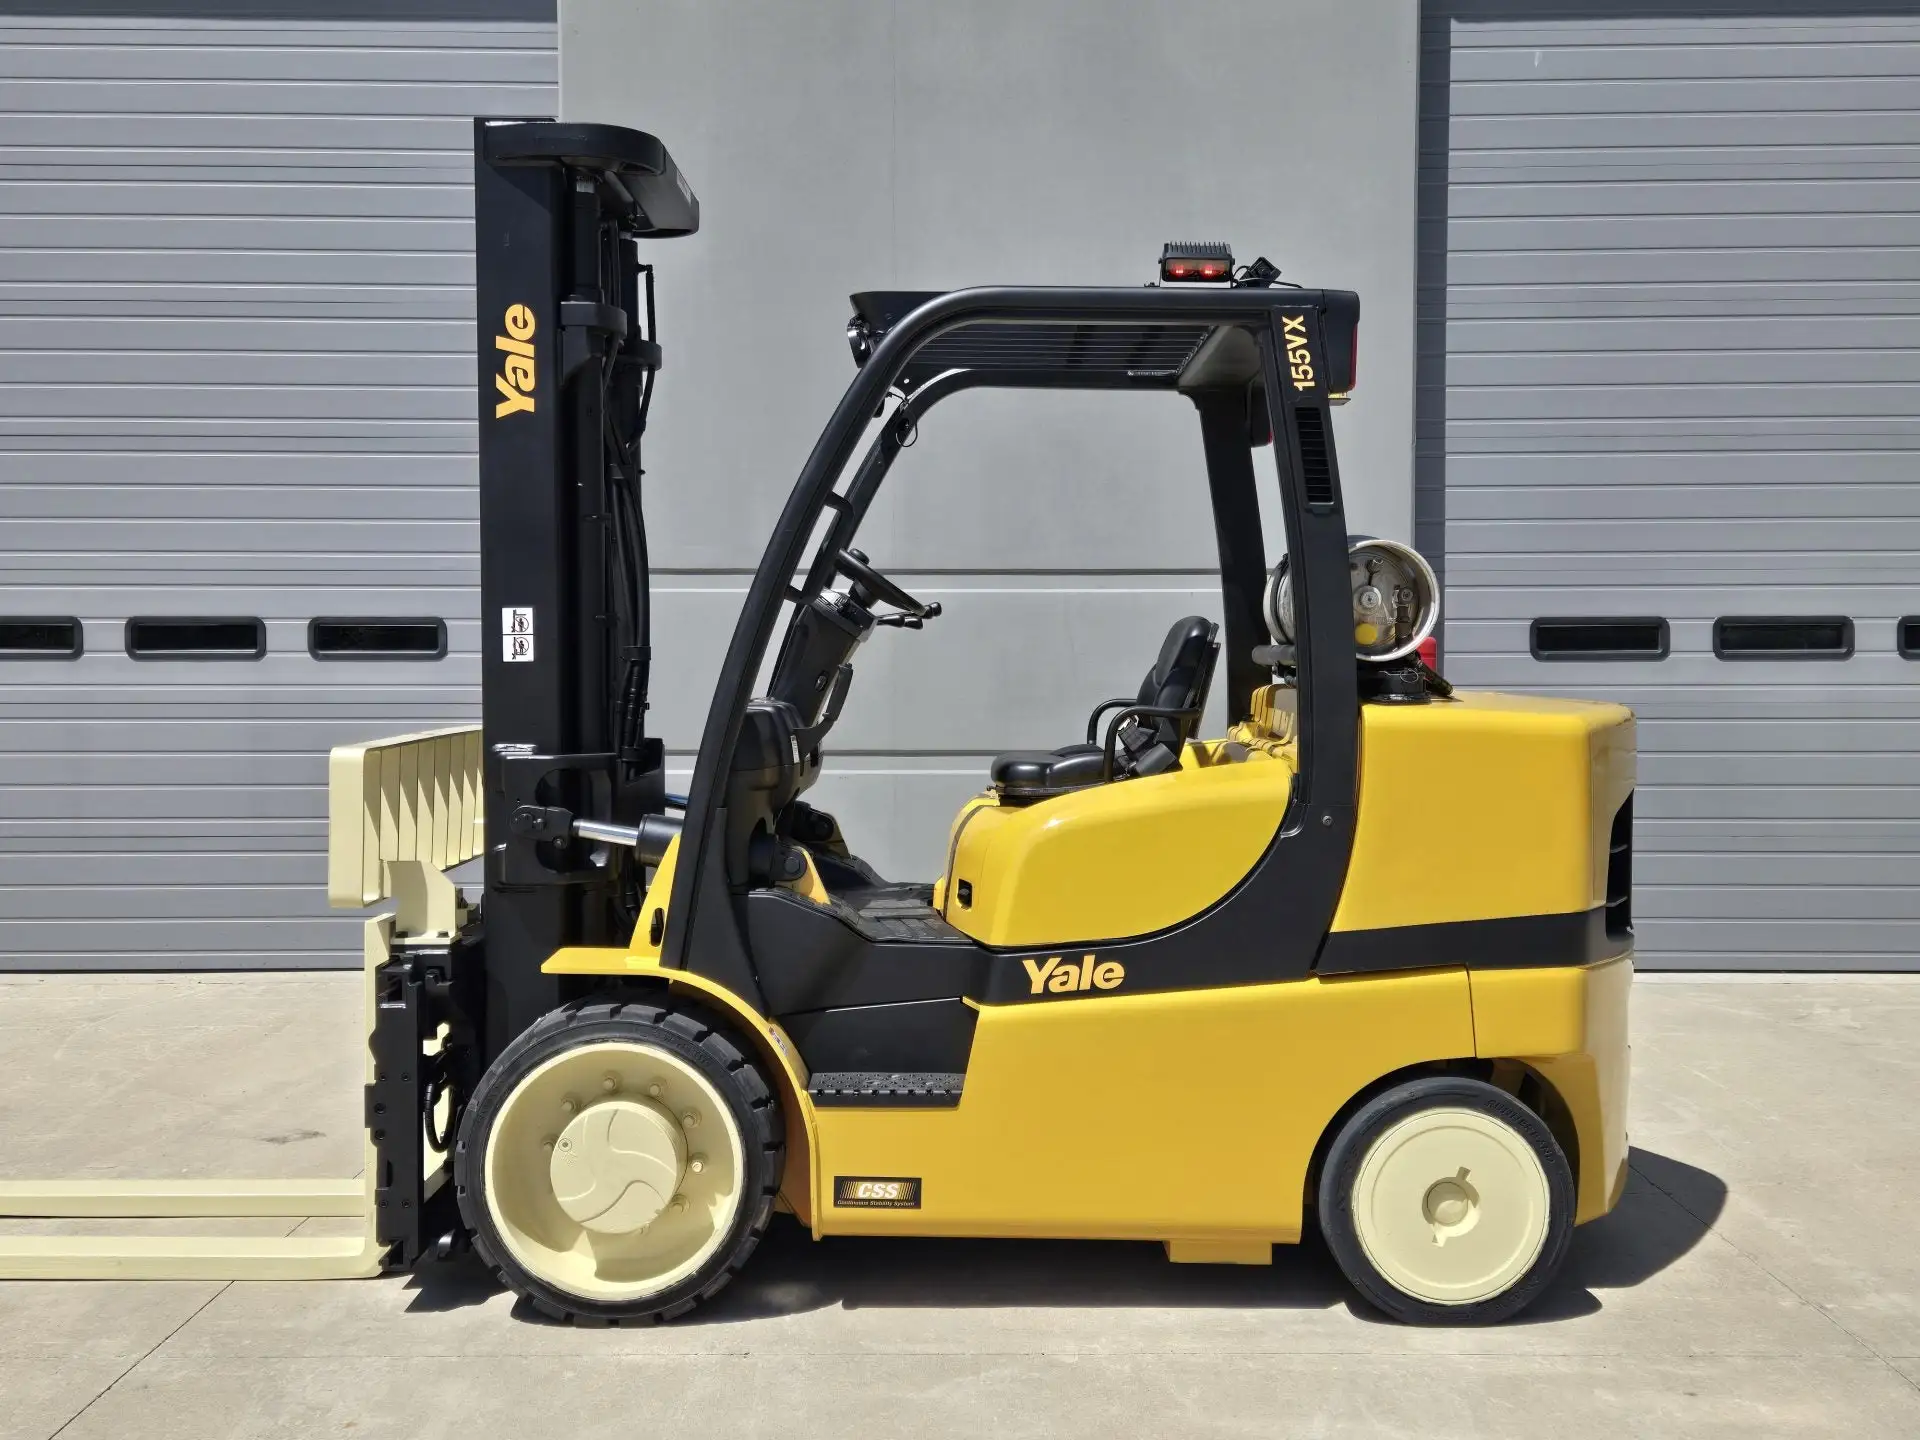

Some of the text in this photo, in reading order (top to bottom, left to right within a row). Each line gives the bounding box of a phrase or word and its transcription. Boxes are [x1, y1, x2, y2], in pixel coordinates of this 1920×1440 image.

[496, 304, 535, 419] Yale
[1281, 315, 1316, 391] 155VX
[1022, 954, 1125, 994] Yale
[857, 1183, 899, 1199] CSS
